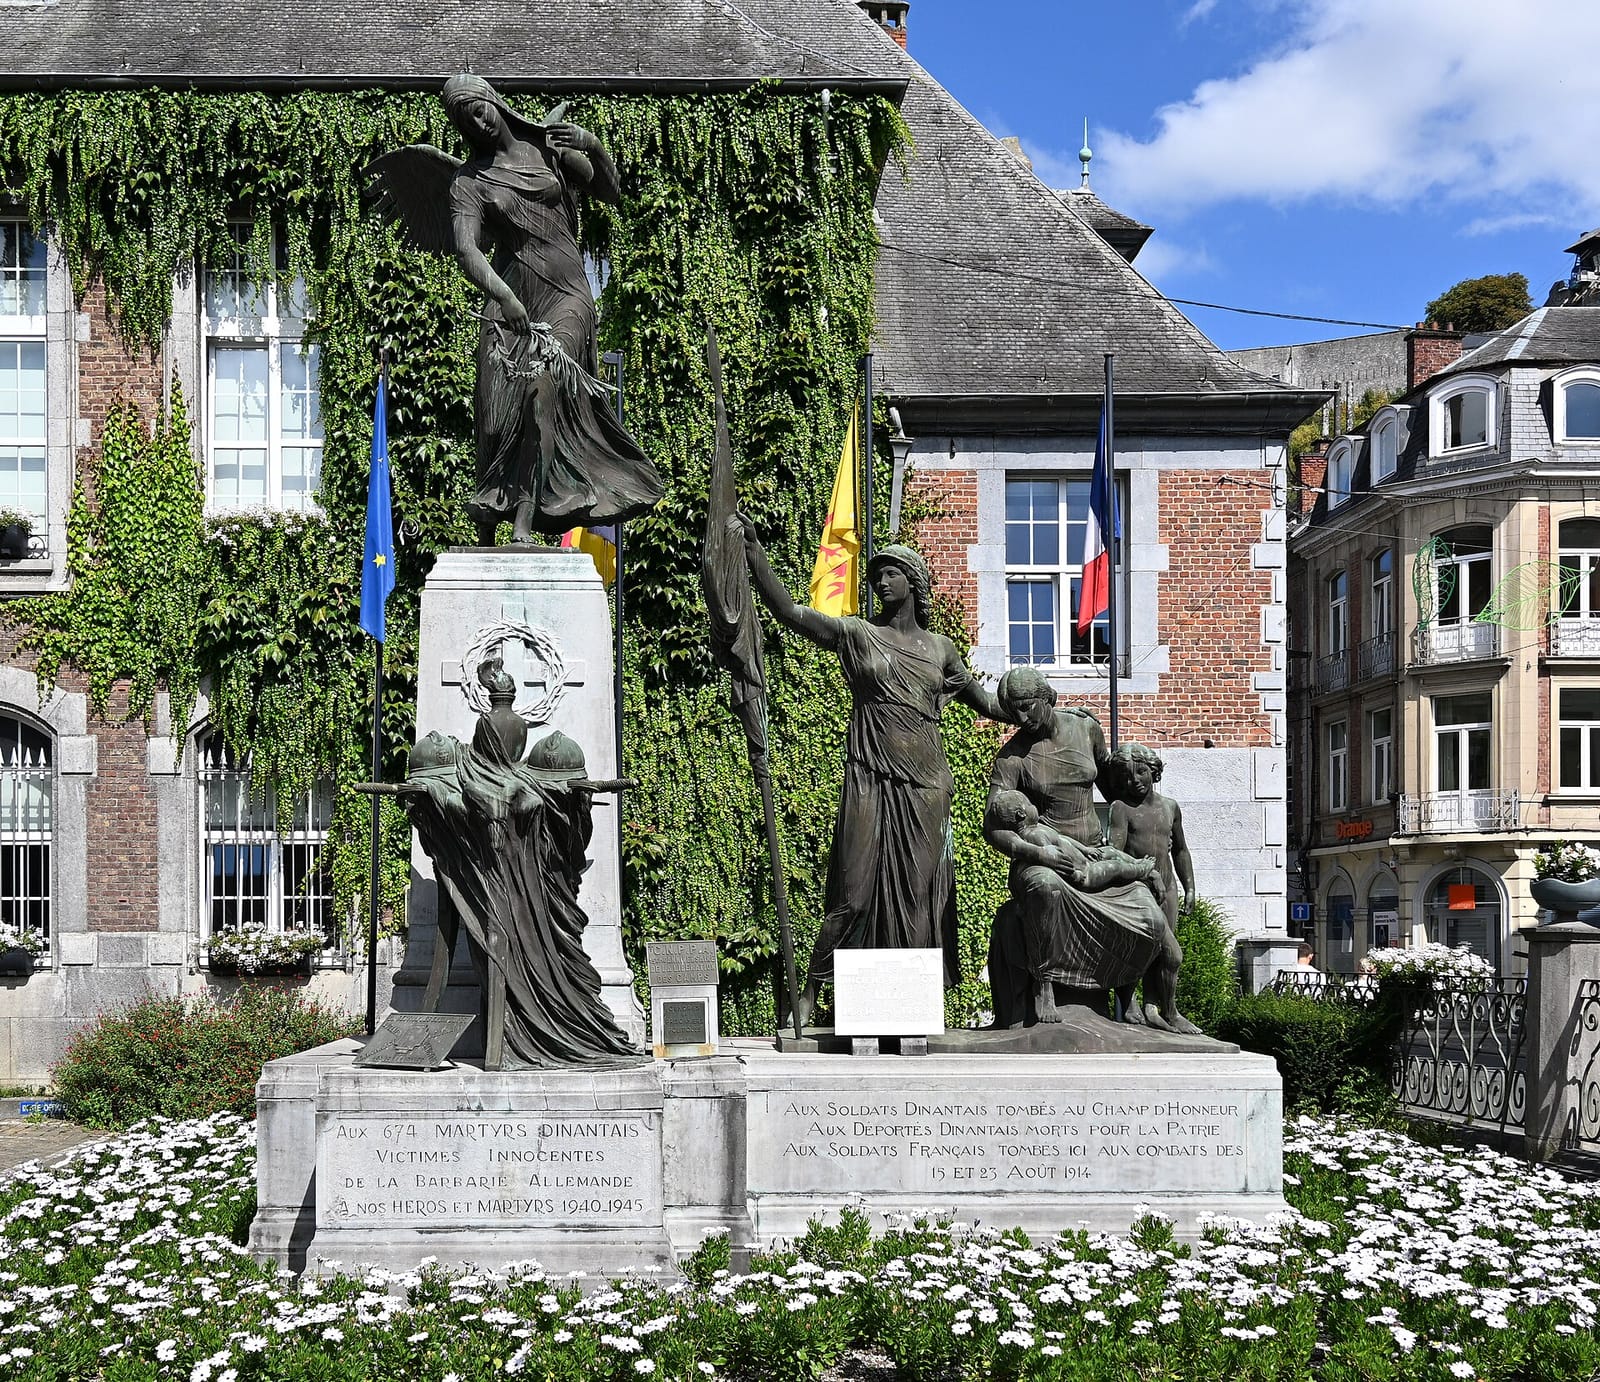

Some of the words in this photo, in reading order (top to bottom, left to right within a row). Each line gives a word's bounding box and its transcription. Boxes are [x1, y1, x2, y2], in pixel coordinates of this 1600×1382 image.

[1336, 819, 1373, 840] Orange
[1062, 1105, 1085, 1116] AU
[383, 1124, 418, 1144] 674
[435, 1123, 527, 1141] MARTYRS
[541, 1123, 639, 1138] DINANTAIS
[1025, 1125, 1079, 1137] MORTS
[1089, 1125, 1131, 1136] POUR
[1138, 1125, 1160, 1136] LA
[1069, 1145, 1086, 1156] ICI
[1098, 1145, 1130, 1157] AUX
[1136, 1144, 1208, 1157] COMBATS
[1216, 1145, 1244, 1157] DES
[932, 1167, 945, 1180] 15
[953, 1167, 974, 1179] ET
[980, 1167, 997, 1180] 23
[1064, 1165, 1092, 1180] 1914
[345, 1177, 365, 1188] DE
[377, 1177, 398, 1188] LA
[357, 1202, 387, 1214] NOS
[393, 1200, 447, 1216] HEROS
[453, 1201, 472, 1213] ET
[478, 1199, 554, 1215] MARTYRS
